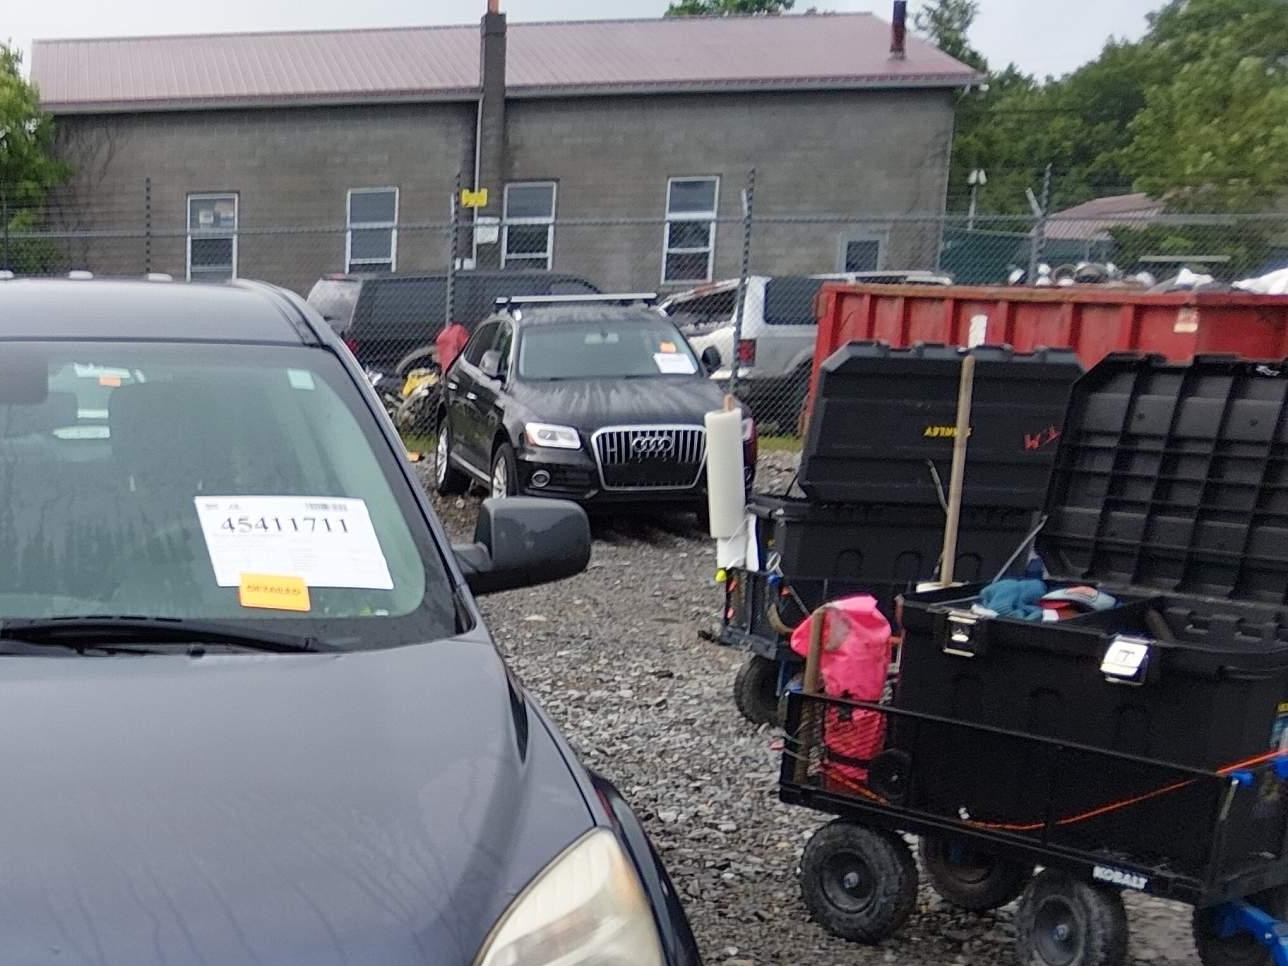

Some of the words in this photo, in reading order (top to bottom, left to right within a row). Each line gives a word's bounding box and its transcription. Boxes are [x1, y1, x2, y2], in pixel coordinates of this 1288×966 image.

[923, 426, 972, 437] SANLEY
[221, 517, 349, 534] 45411711
[1093, 865, 1148, 890] KOBALT
